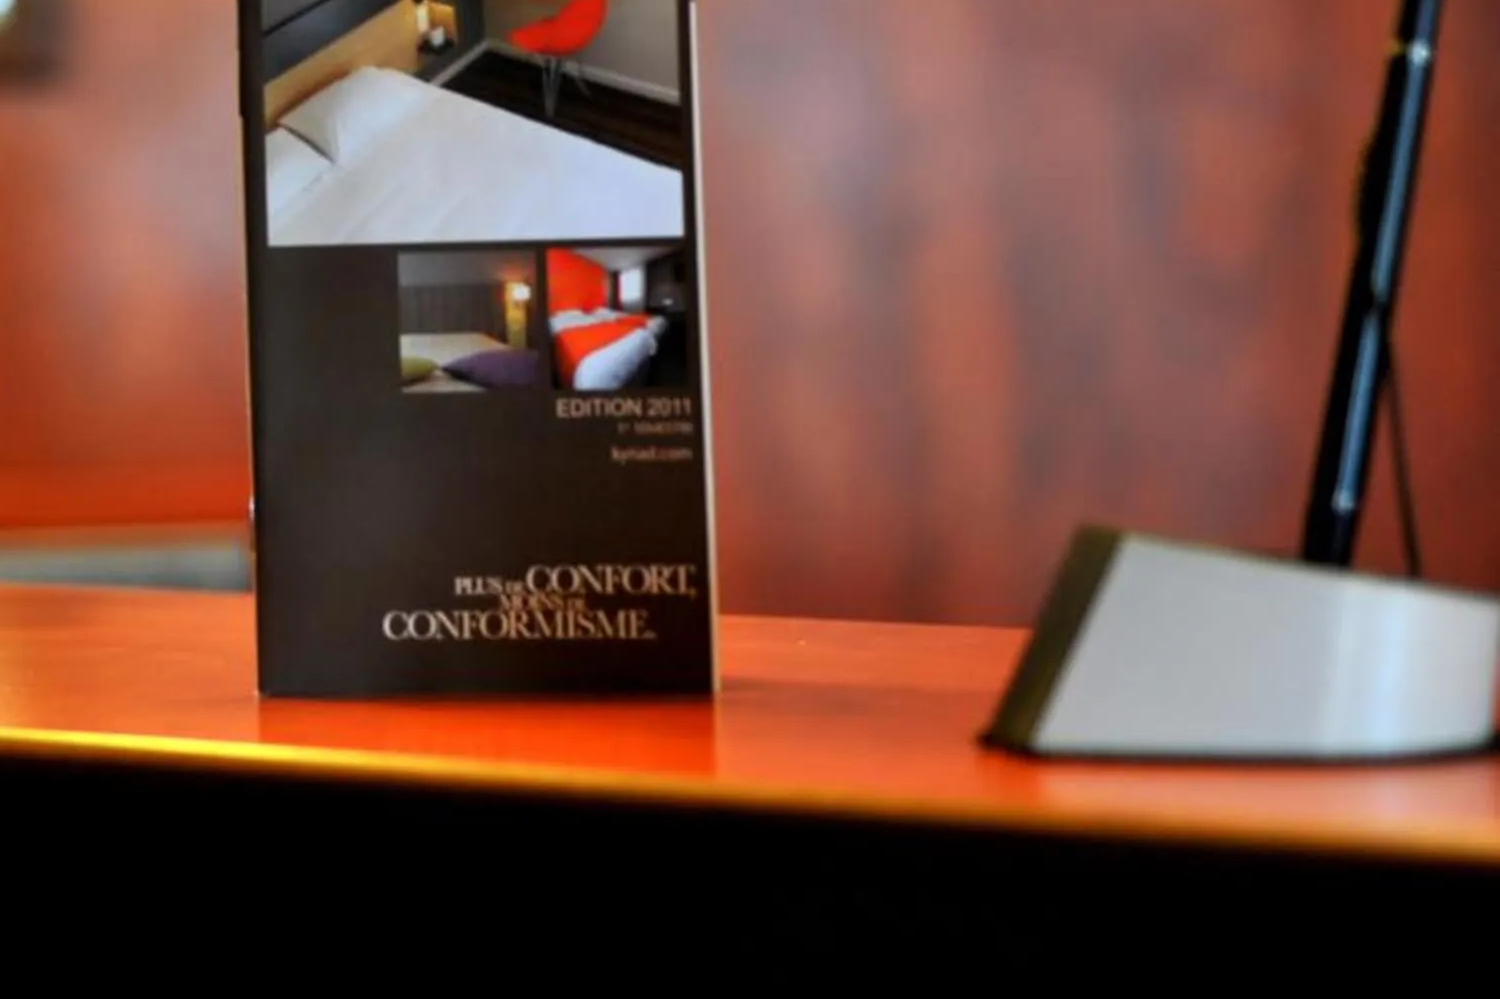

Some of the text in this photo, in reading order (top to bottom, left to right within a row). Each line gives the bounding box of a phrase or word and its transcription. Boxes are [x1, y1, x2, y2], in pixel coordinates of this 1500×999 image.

[555, 396, 692, 418] EDITION 2011
[611, 446, 693, 466] kyrad
[454, 576, 503, 596] PLUS
